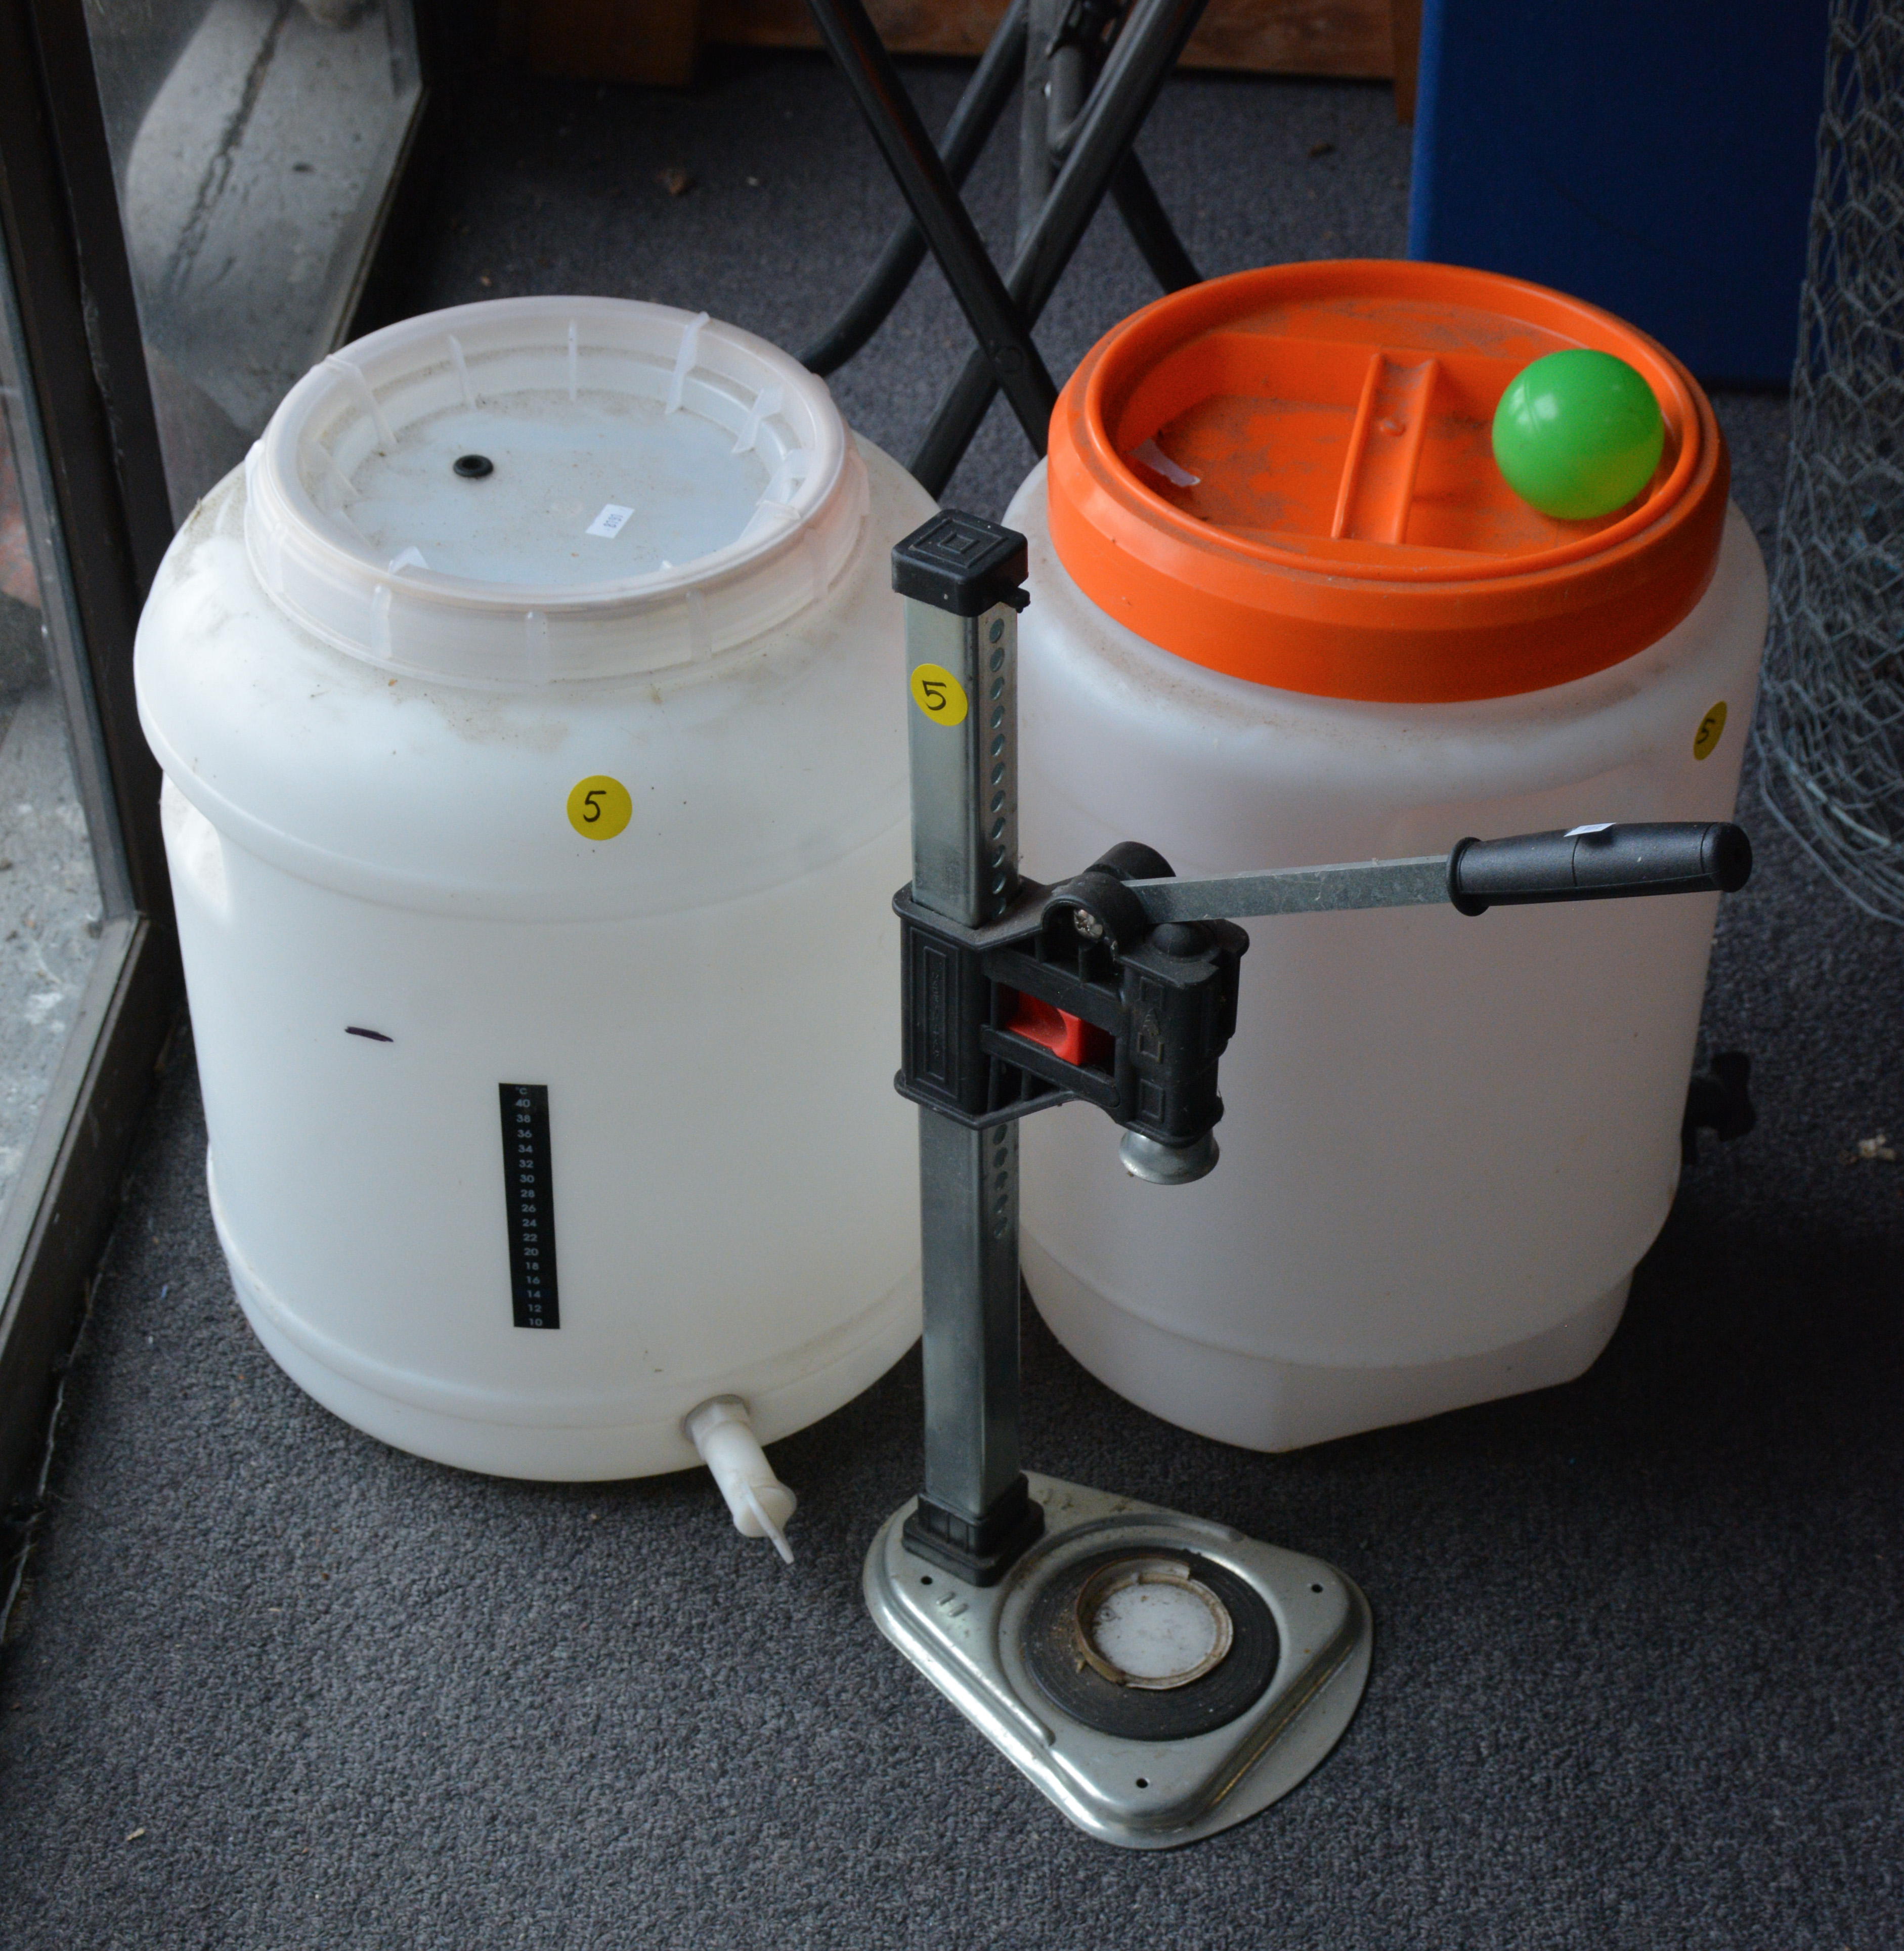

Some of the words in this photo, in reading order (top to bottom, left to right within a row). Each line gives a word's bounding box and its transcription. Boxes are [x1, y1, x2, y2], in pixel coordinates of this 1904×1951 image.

[922, 679, 947, 711] 5
[1696, 718, 1716, 745] 5
[583, 790, 607, 822] 5
[515, 1099, 531, 1108] 40
[516, 1114, 531, 1123] 38
[517, 1129, 532, 1138] 36
[518, 1144, 533, 1153] 34
[519, 1159, 534, 1168] 32
[520, 1175, 535, 1183] 30
[521, 1189, 535, 1198] 28
[522, 1204, 536, 1212] 26
[522, 1219, 537, 1227] 24
[523, 1233, 538, 1242] 22
[524, 1247, 539, 1256] 20
[526, 1262, 539, 1270] 18
[527, 1276, 540, 1284] 16
[527, 1290, 541, 1298] 14
[528, 1304, 542, 1313] 12
[529, 1318, 543, 1326] 10
